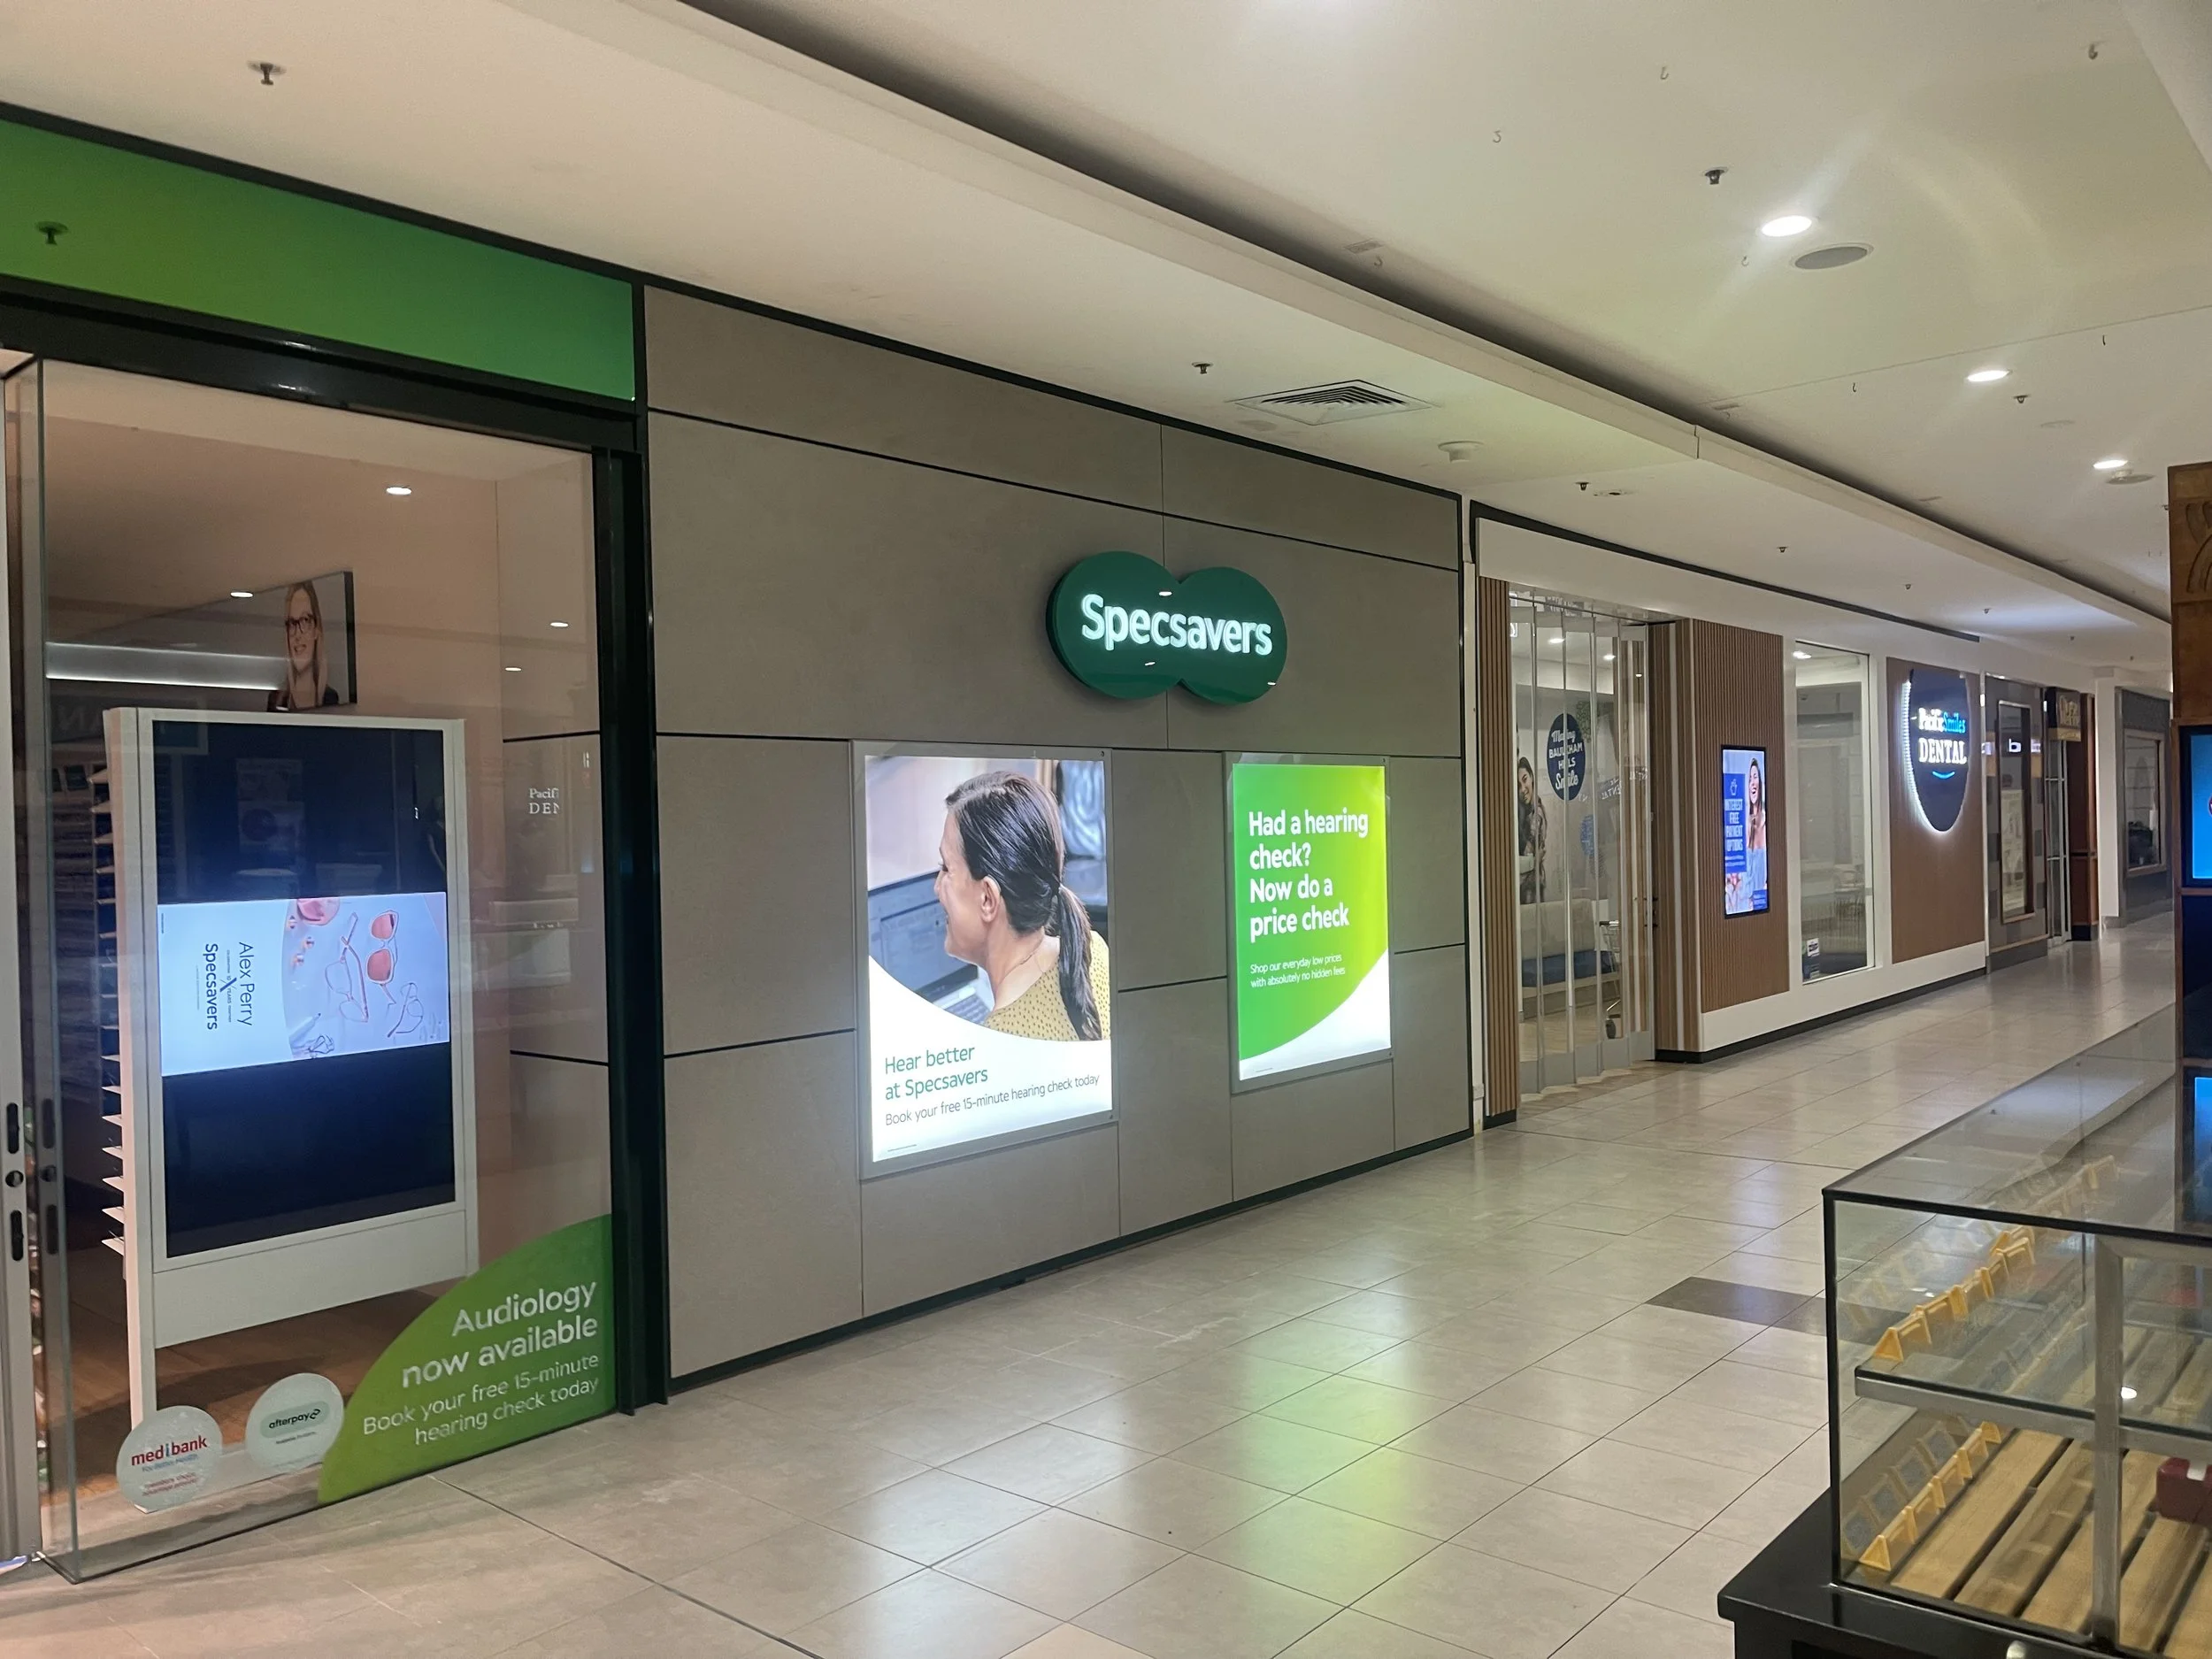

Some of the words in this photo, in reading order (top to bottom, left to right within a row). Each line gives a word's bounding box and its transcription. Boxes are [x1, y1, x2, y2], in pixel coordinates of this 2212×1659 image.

[1081, 594, 1272, 656] Specsavers
[1918, 737, 1967, 764] DENTAL
[1248, 810, 1286, 836] Had
[1290, 816, 1302, 834] a
[1304, 807, 1369, 838] hearing
[1249, 842, 1311, 870] check?
[1249, 878, 1293, 903] Now
[1297, 873, 1320, 899] do
[1324, 878, 1333, 896] a
[1250, 907, 1298, 943] price
[1302, 902, 1350, 931] check
[239, 941, 255, 979] Alex
[1249, 964, 1269, 974] Shop
[1269, 963, 1281, 972] our
[1282, 957, 1311, 969] everyday
[1312, 956, 1324, 965] low
[1324, 954, 1342, 966] prices
[1250, 977, 1266, 988] with
[1267, 972, 1301, 986] absolutely
[1302, 972, 1311, 980] no
[1311, 968, 1333, 979] hidden
[1333, 966, 1346, 976] fees
[203, 943, 219, 1030] Specsavers
[237, 983, 255, 1026] Perry
[885, 1055, 921, 1074] Hear
[926, 1047, 975, 1067] better
[885, 1082, 901, 1100] at
[905, 1068, 988, 1099] Specsavers
[886, 1110, 912, 1125] Book
[915, 1105, 938, 1123] your
[941, 1101, 961, 1115] free
[963, 1092, 1010, 1110] 15-minute
[1011, 1084, 1046, 1099] hearing
[1048, 1078, 1072, 1093] check
[1075, 1073, 1100, 1087] today
[451, 1282, 596, 1337] Audiology
[403, 1351, 470, 1388] now
[478, 1315, 598, 1367] available
[364, 1406, 416, 1435] Book
[421, 1393, 466, 1422] your
[472, 1381, 510, 1403] free
[514, 1354, 599, 1390] 15-minute
[415, 1411, 488, 1445] hearing
[492, 1392, 546, 1421] check
[550, 1378, 599, 1402] today
[269, 1412, 311, 1429] afterpay
[132, 1434, 208, 1466] medibank
